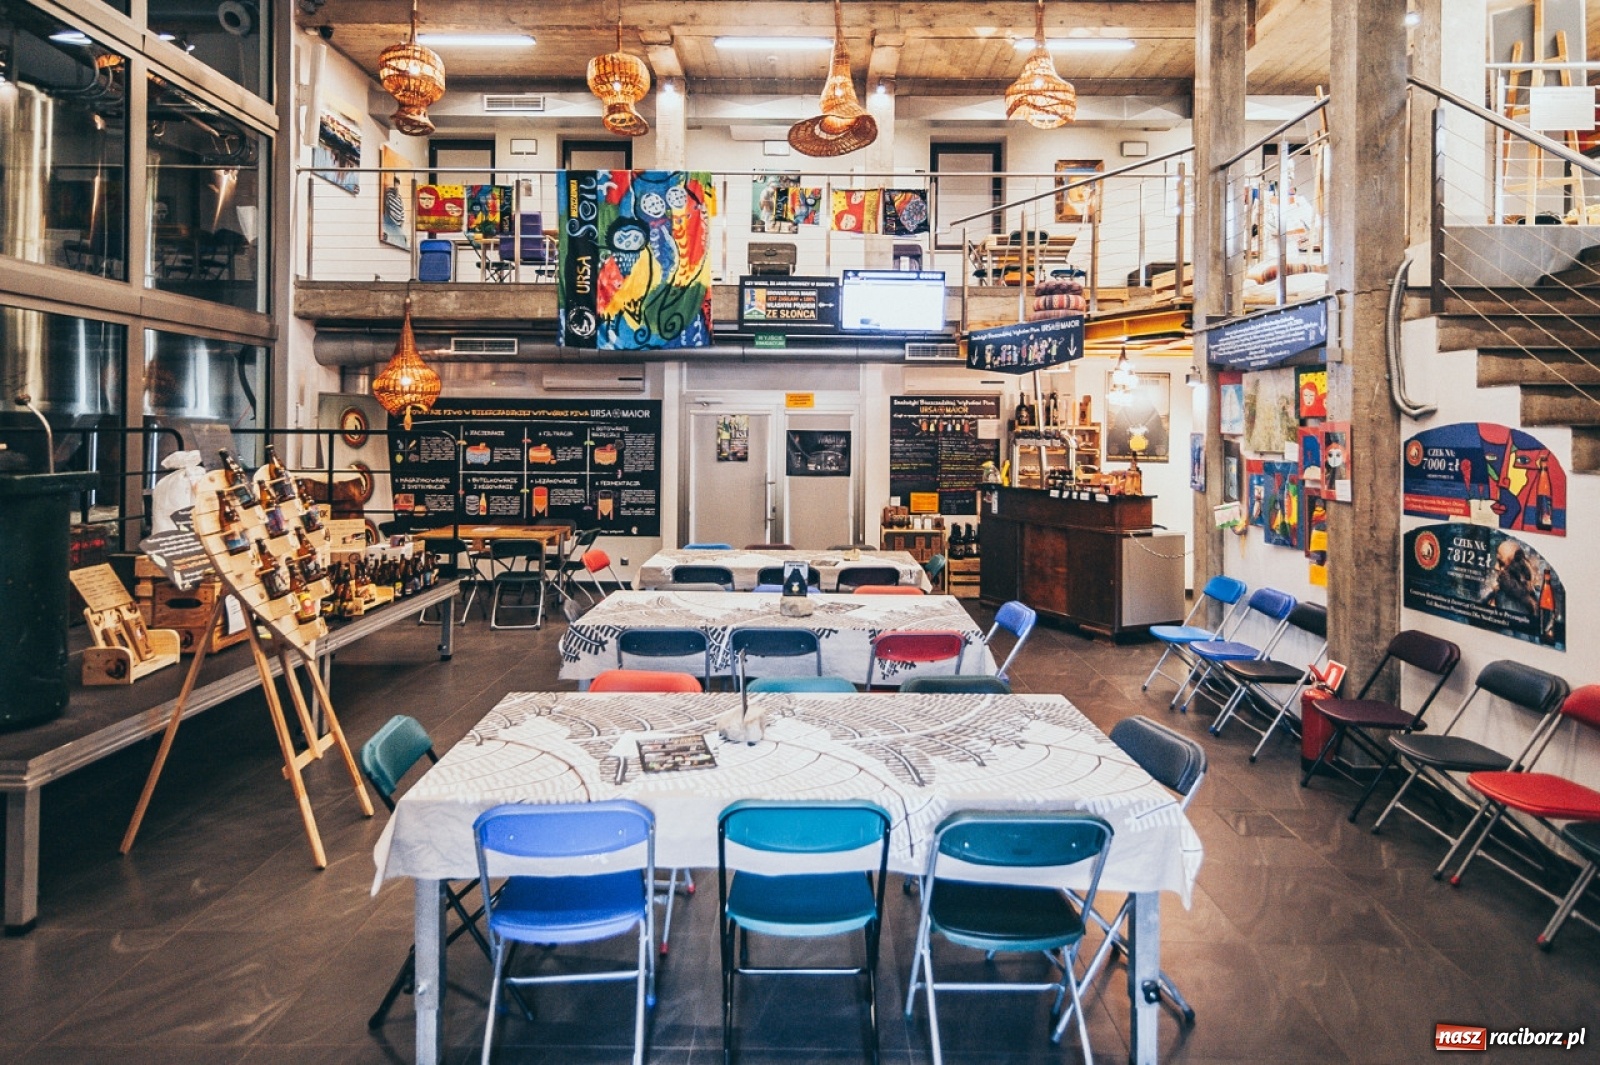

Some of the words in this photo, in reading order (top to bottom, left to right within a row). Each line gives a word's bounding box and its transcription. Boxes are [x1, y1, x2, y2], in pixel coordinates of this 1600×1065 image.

[576, 255, 592, 294] URSA
[767, 310, 778, 318] ZE
[780, 308, 816, 319] SŁOŃCA
[1041, 324, 1055, 332] URSA
[1060, 320, 1080, 330] MAIOR
[590, 409, 611, 418] URSA
[622, 409, 651, 418] MAIOR
[920, 406, 937, 414] URSA
[945, 406, 969, 414] MAIOR
[1427, 448, 1445, 457] CZEK
[1422, 458, 1446, 471] 7000
[1448, 458, 1460, 472] zł
[1453, 537, 1474, 548] CZEK
[1447, 547, 1476, 566] 7812
[1478, 553, 1493, 568] zł
